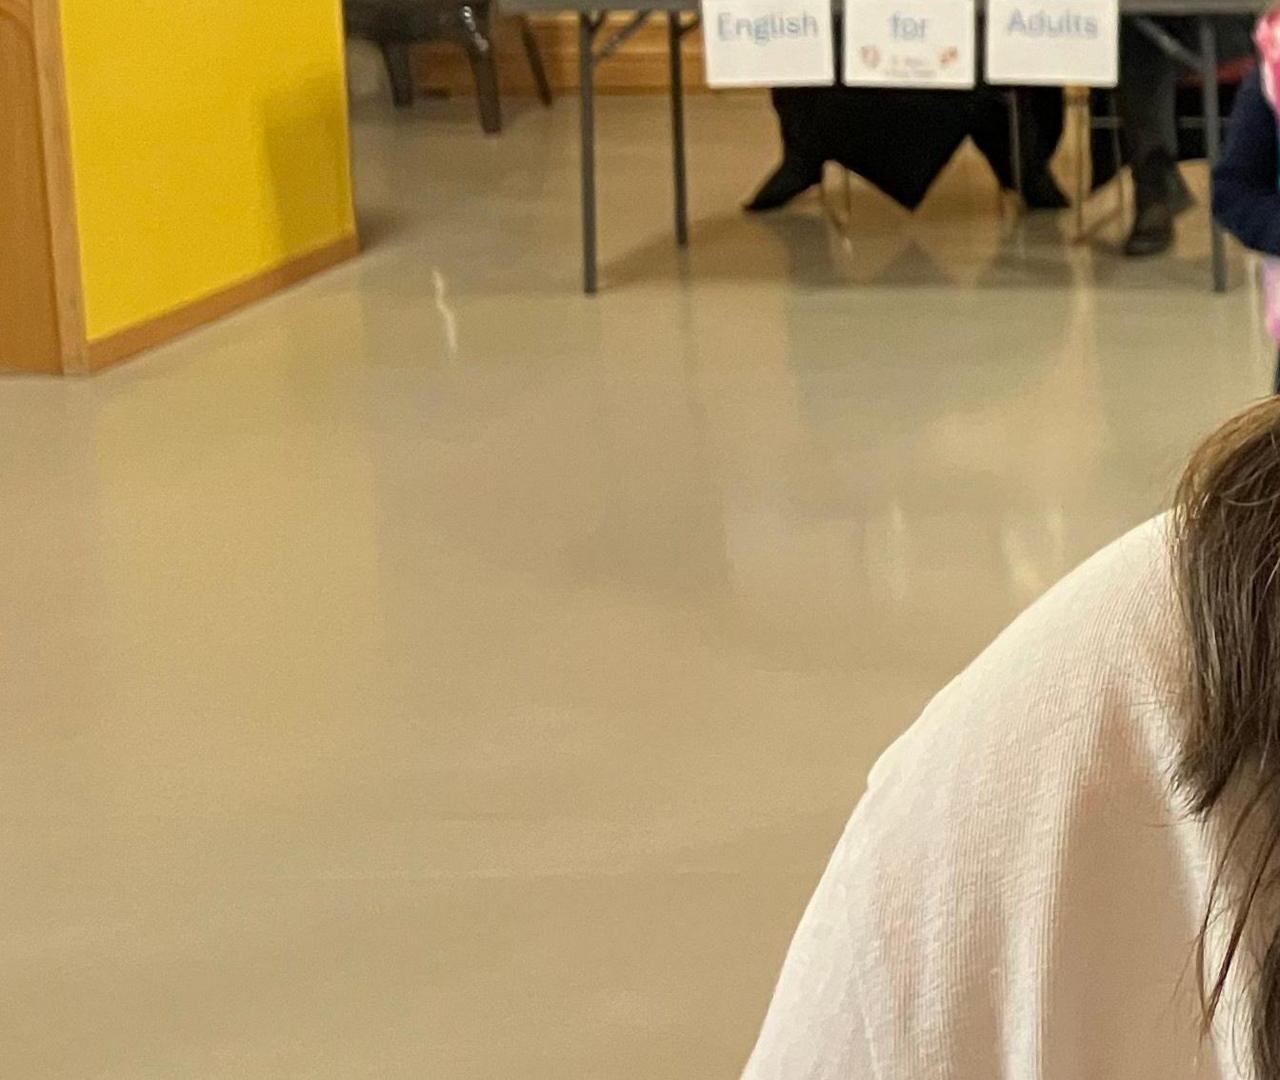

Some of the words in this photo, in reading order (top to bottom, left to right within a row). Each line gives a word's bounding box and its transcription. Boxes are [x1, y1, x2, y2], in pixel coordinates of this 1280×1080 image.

[717, 11, 818, 44] English
[888, 11, 926, 39] for
[1007, 8, 1099, 36] Adults
